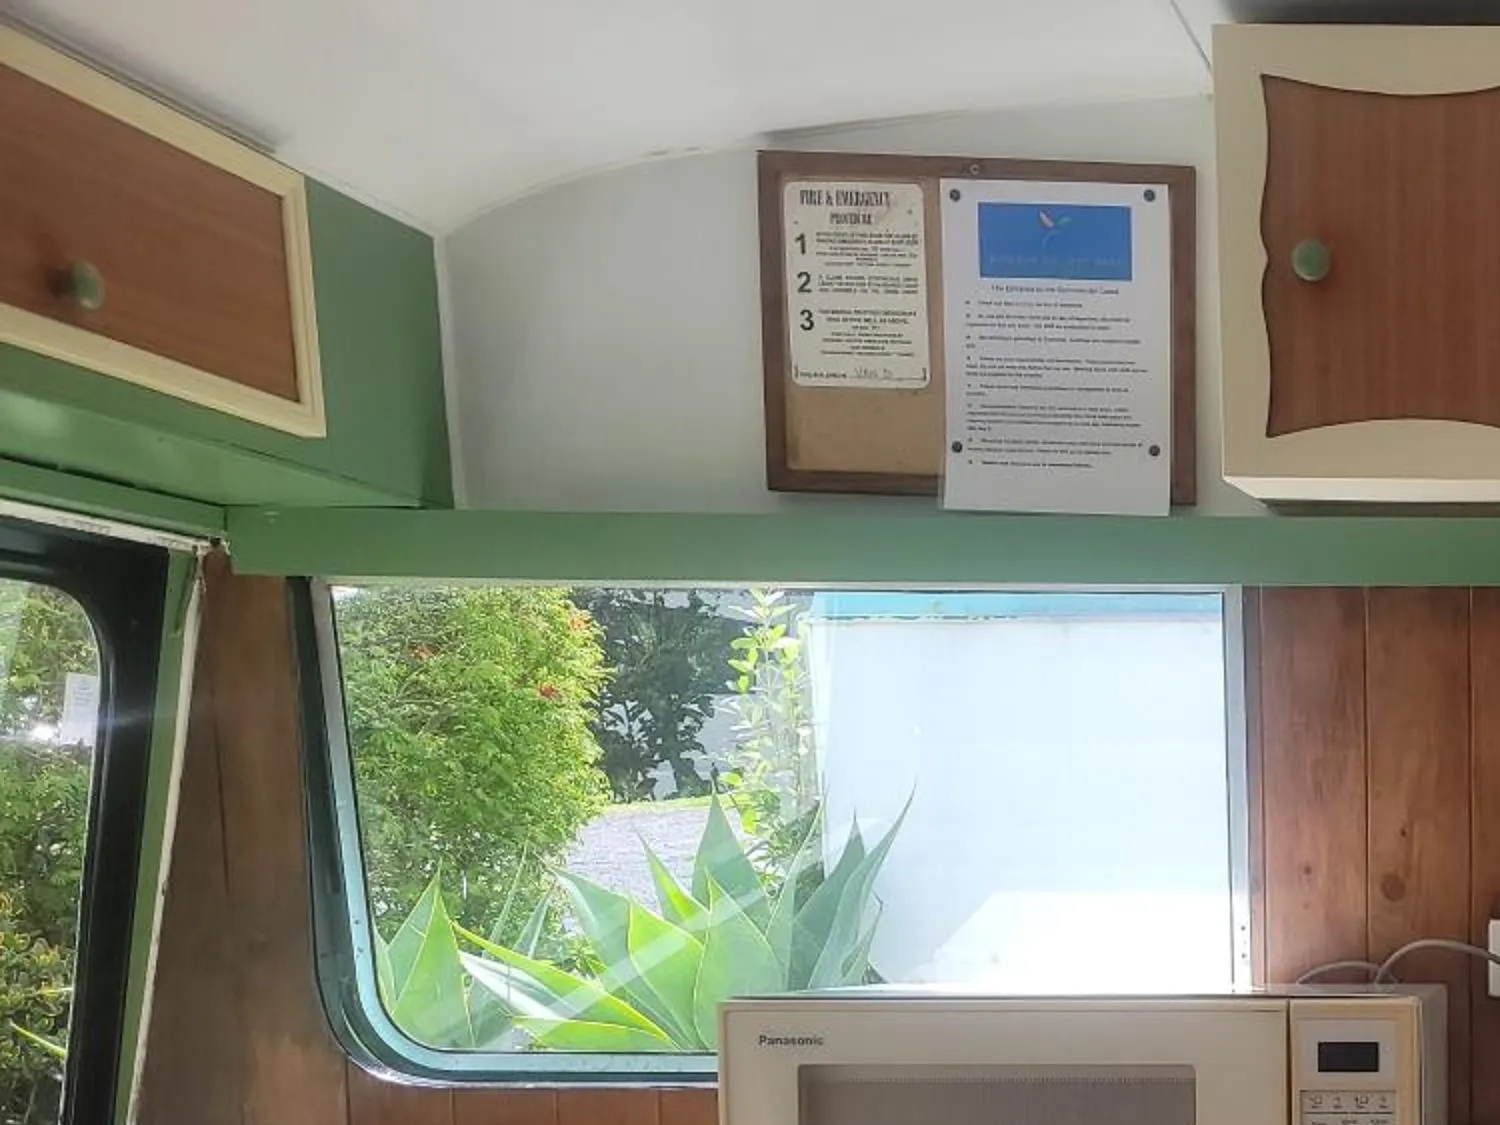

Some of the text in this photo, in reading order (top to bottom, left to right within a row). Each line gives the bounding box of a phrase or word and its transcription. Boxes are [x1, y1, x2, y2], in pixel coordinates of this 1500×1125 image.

[800, 189, 822, 205] FIRE
[836, 190, 890, 208] EMERGENCY
[794, 233, 806, 255] 1
[797, 272, 812, 293] 2
[799, 309, 814, 331] 3
[759, 1035, 824, 1046] Panasonic
